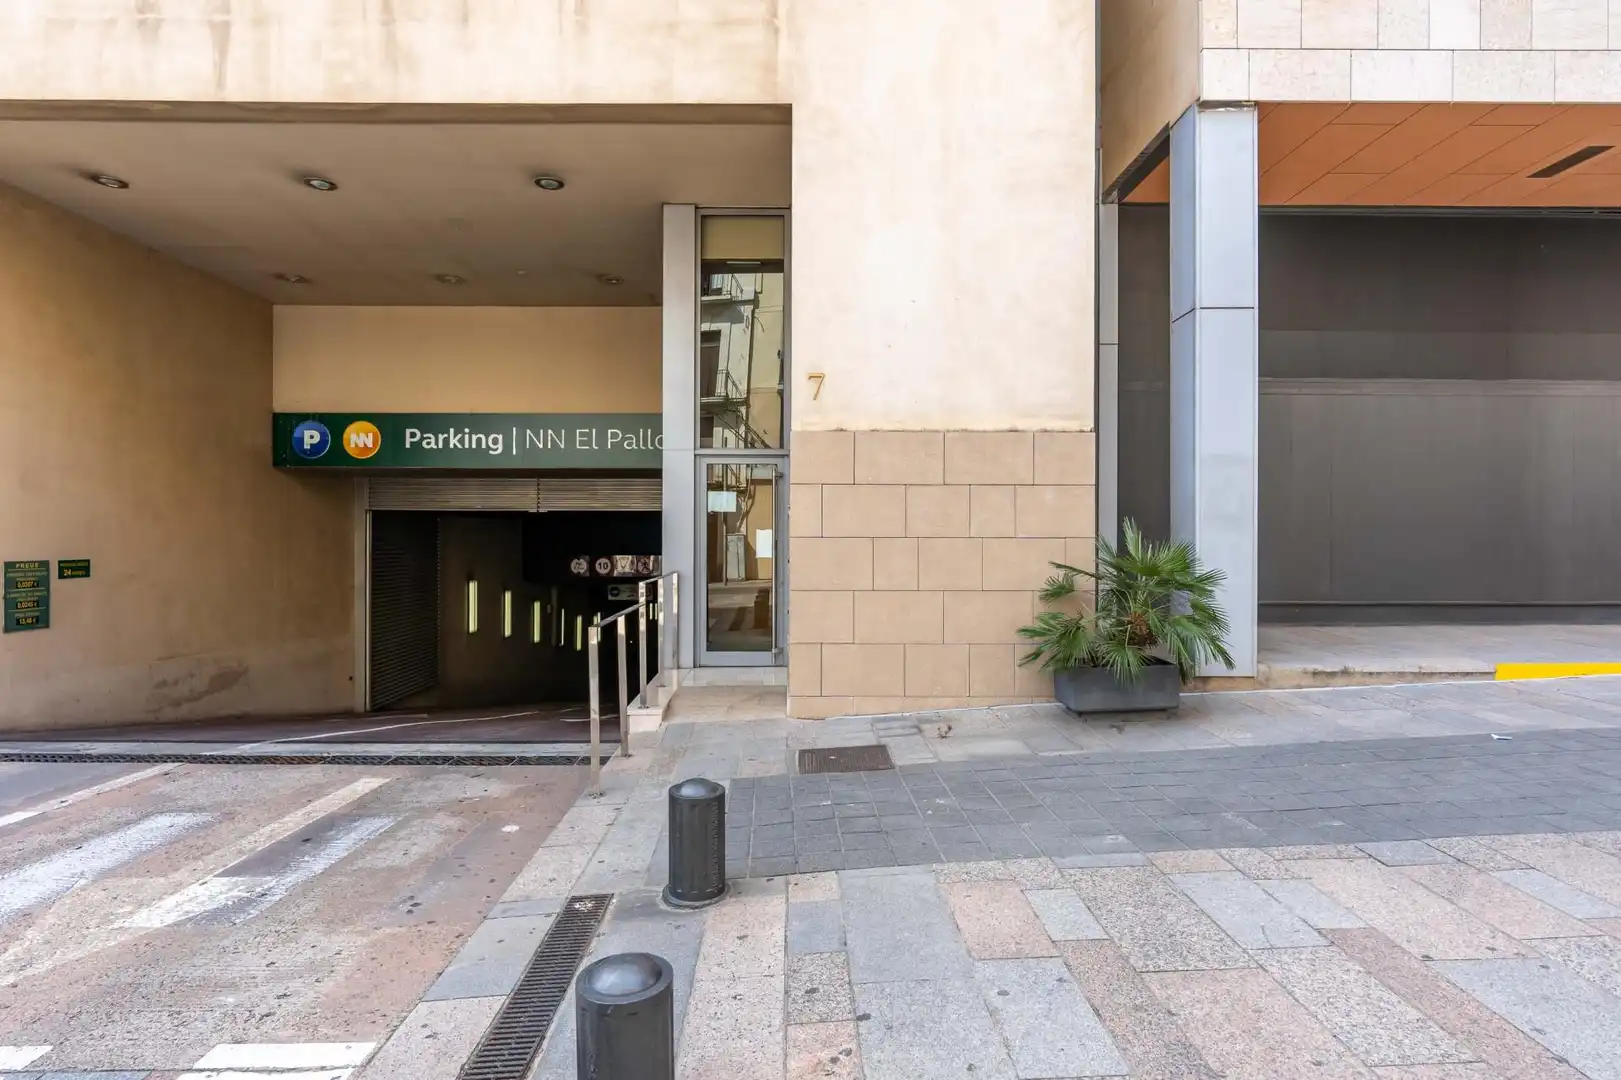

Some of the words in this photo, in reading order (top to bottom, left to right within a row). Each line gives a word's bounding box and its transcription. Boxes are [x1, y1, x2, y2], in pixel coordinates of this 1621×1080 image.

[806, 373, 826, 401] 7
[303, 430, 321, 449] P
[349, 432, 374, 449] NN
[404, 427, 504, 456] Parking
[525, 428, 566, 449] NN
[575, 428, 600, 449] El
[597, 562, 609, 570] 10
